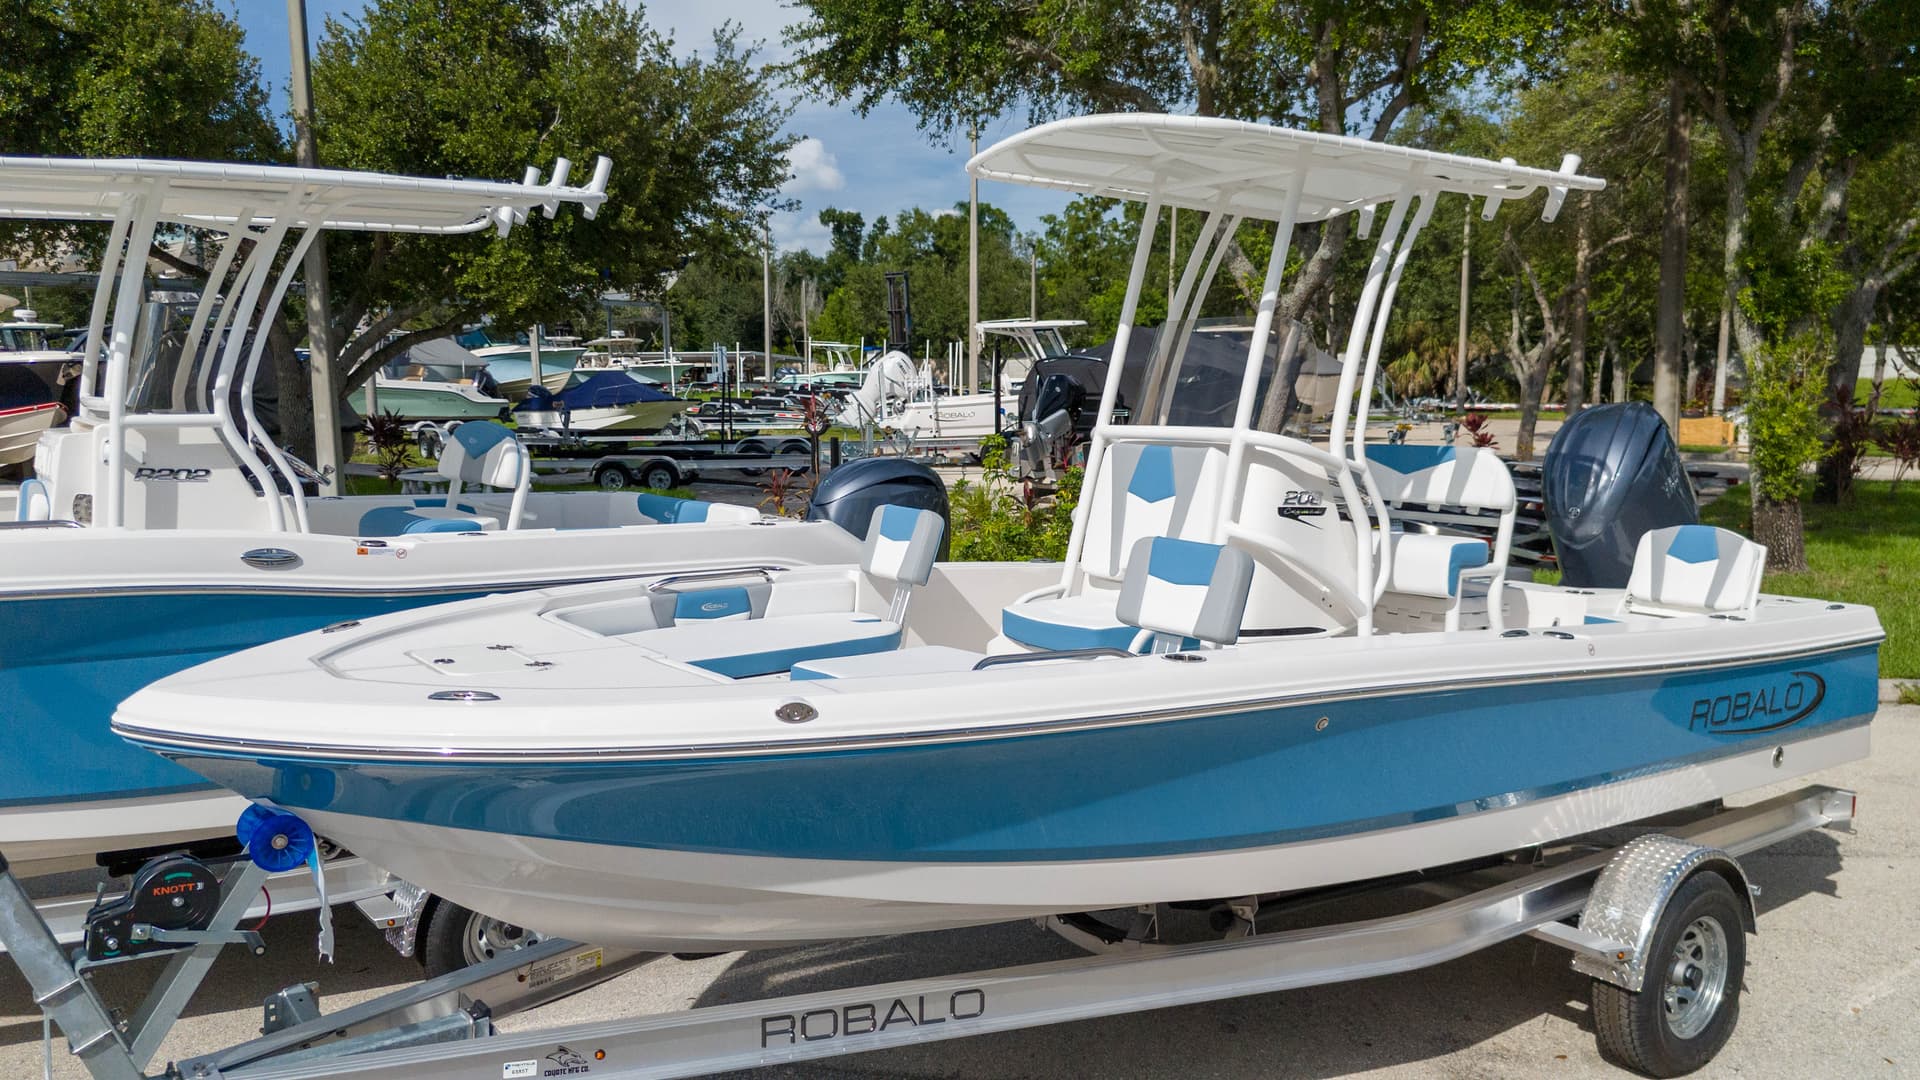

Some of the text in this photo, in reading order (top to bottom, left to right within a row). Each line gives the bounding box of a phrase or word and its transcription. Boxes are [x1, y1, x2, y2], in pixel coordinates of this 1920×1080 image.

[1688, 682, 1804, 731] ROBALO
[152, 882, 196, 897] KNOTT
[761, 988, 985, 1049] ROBALO
[544, 1068, 568, 1078] COYOTE
